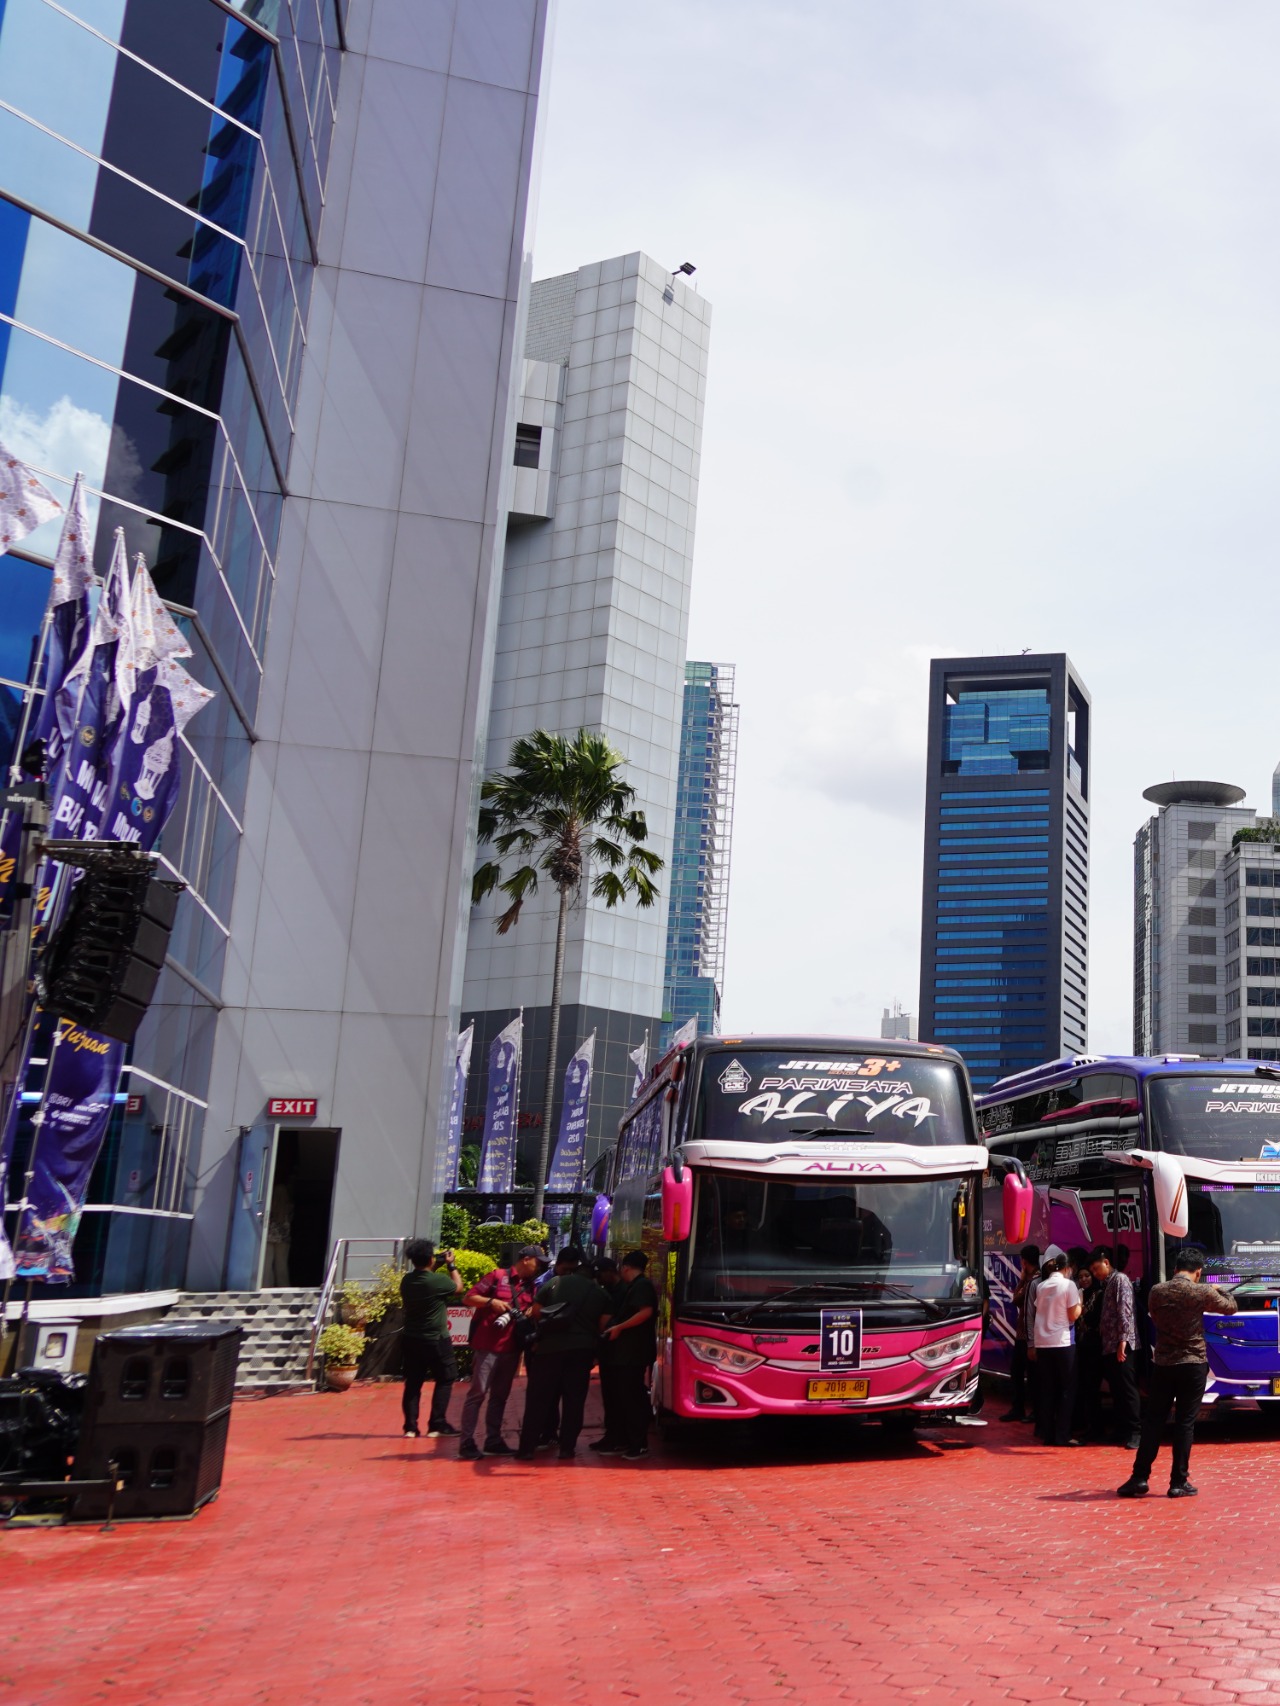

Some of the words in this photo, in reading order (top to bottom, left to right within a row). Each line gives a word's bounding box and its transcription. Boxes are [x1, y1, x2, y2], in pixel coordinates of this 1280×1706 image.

[60, 1018, 111, 1055] Tujuan
[778, 1060, 861, 1071] JETBUS
[857, 1058, 901, 1076] 3+
[759, 1078, 913, 1094] PARIWISATA
[271, 1101, 315, 1113] EXIT
[802, 1162, 887, 1172] ALIYA
[829, 1330, 854, 1356] 10
[812, 1382, 818, 1393] G
[1275, 1379, 1280, 1389] G
